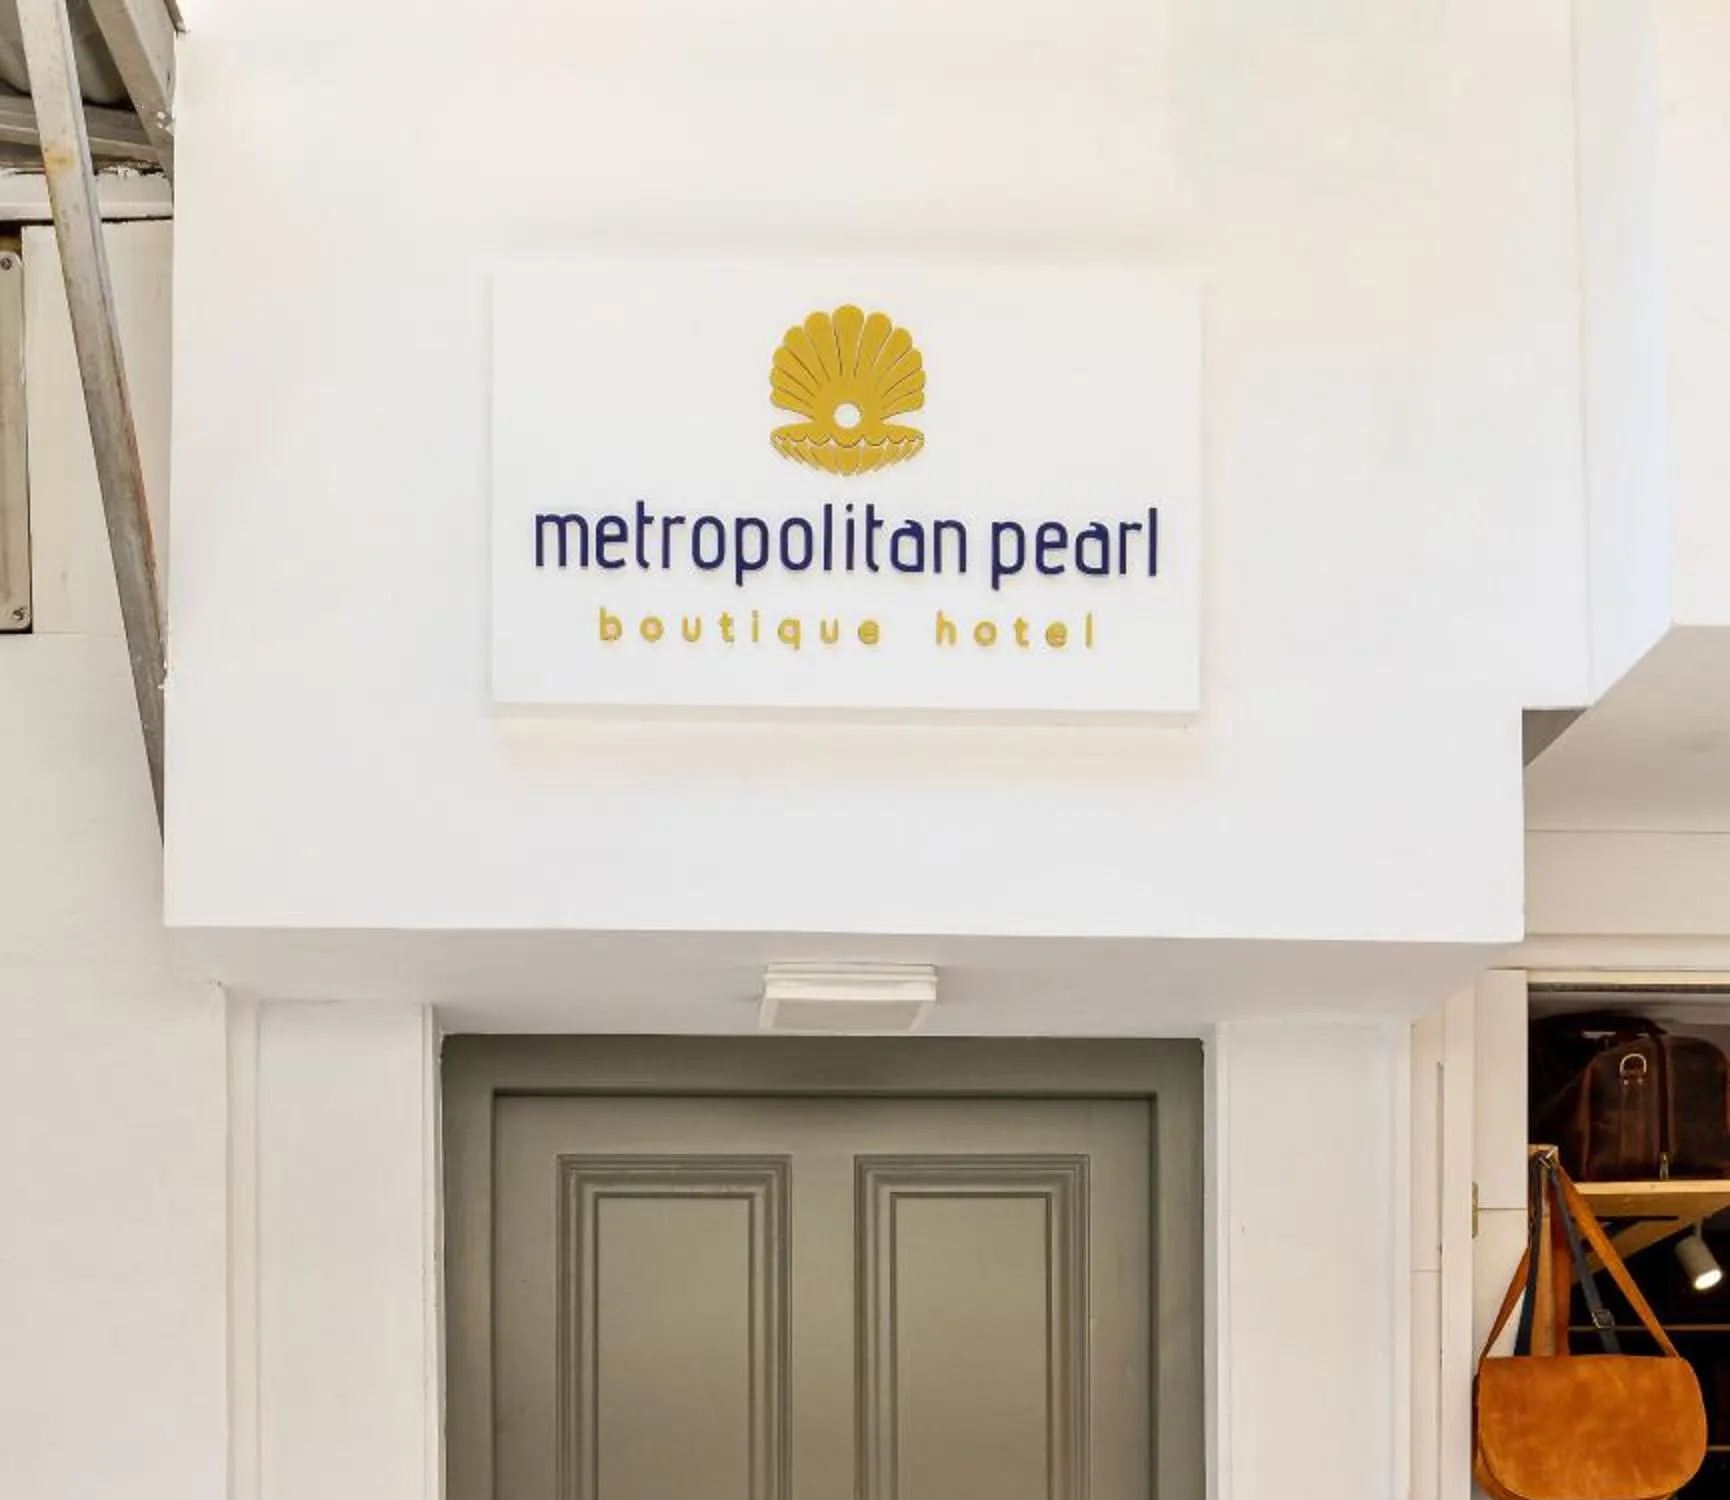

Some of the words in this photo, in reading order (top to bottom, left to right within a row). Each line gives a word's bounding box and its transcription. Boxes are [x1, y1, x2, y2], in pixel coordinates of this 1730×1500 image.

[534, 499, 967, 588] metropolitan
[990, 506, 1159, 592] pearl
[598, 607, 881, 651] boutique
[935, 610, 1096, 650] hotel
